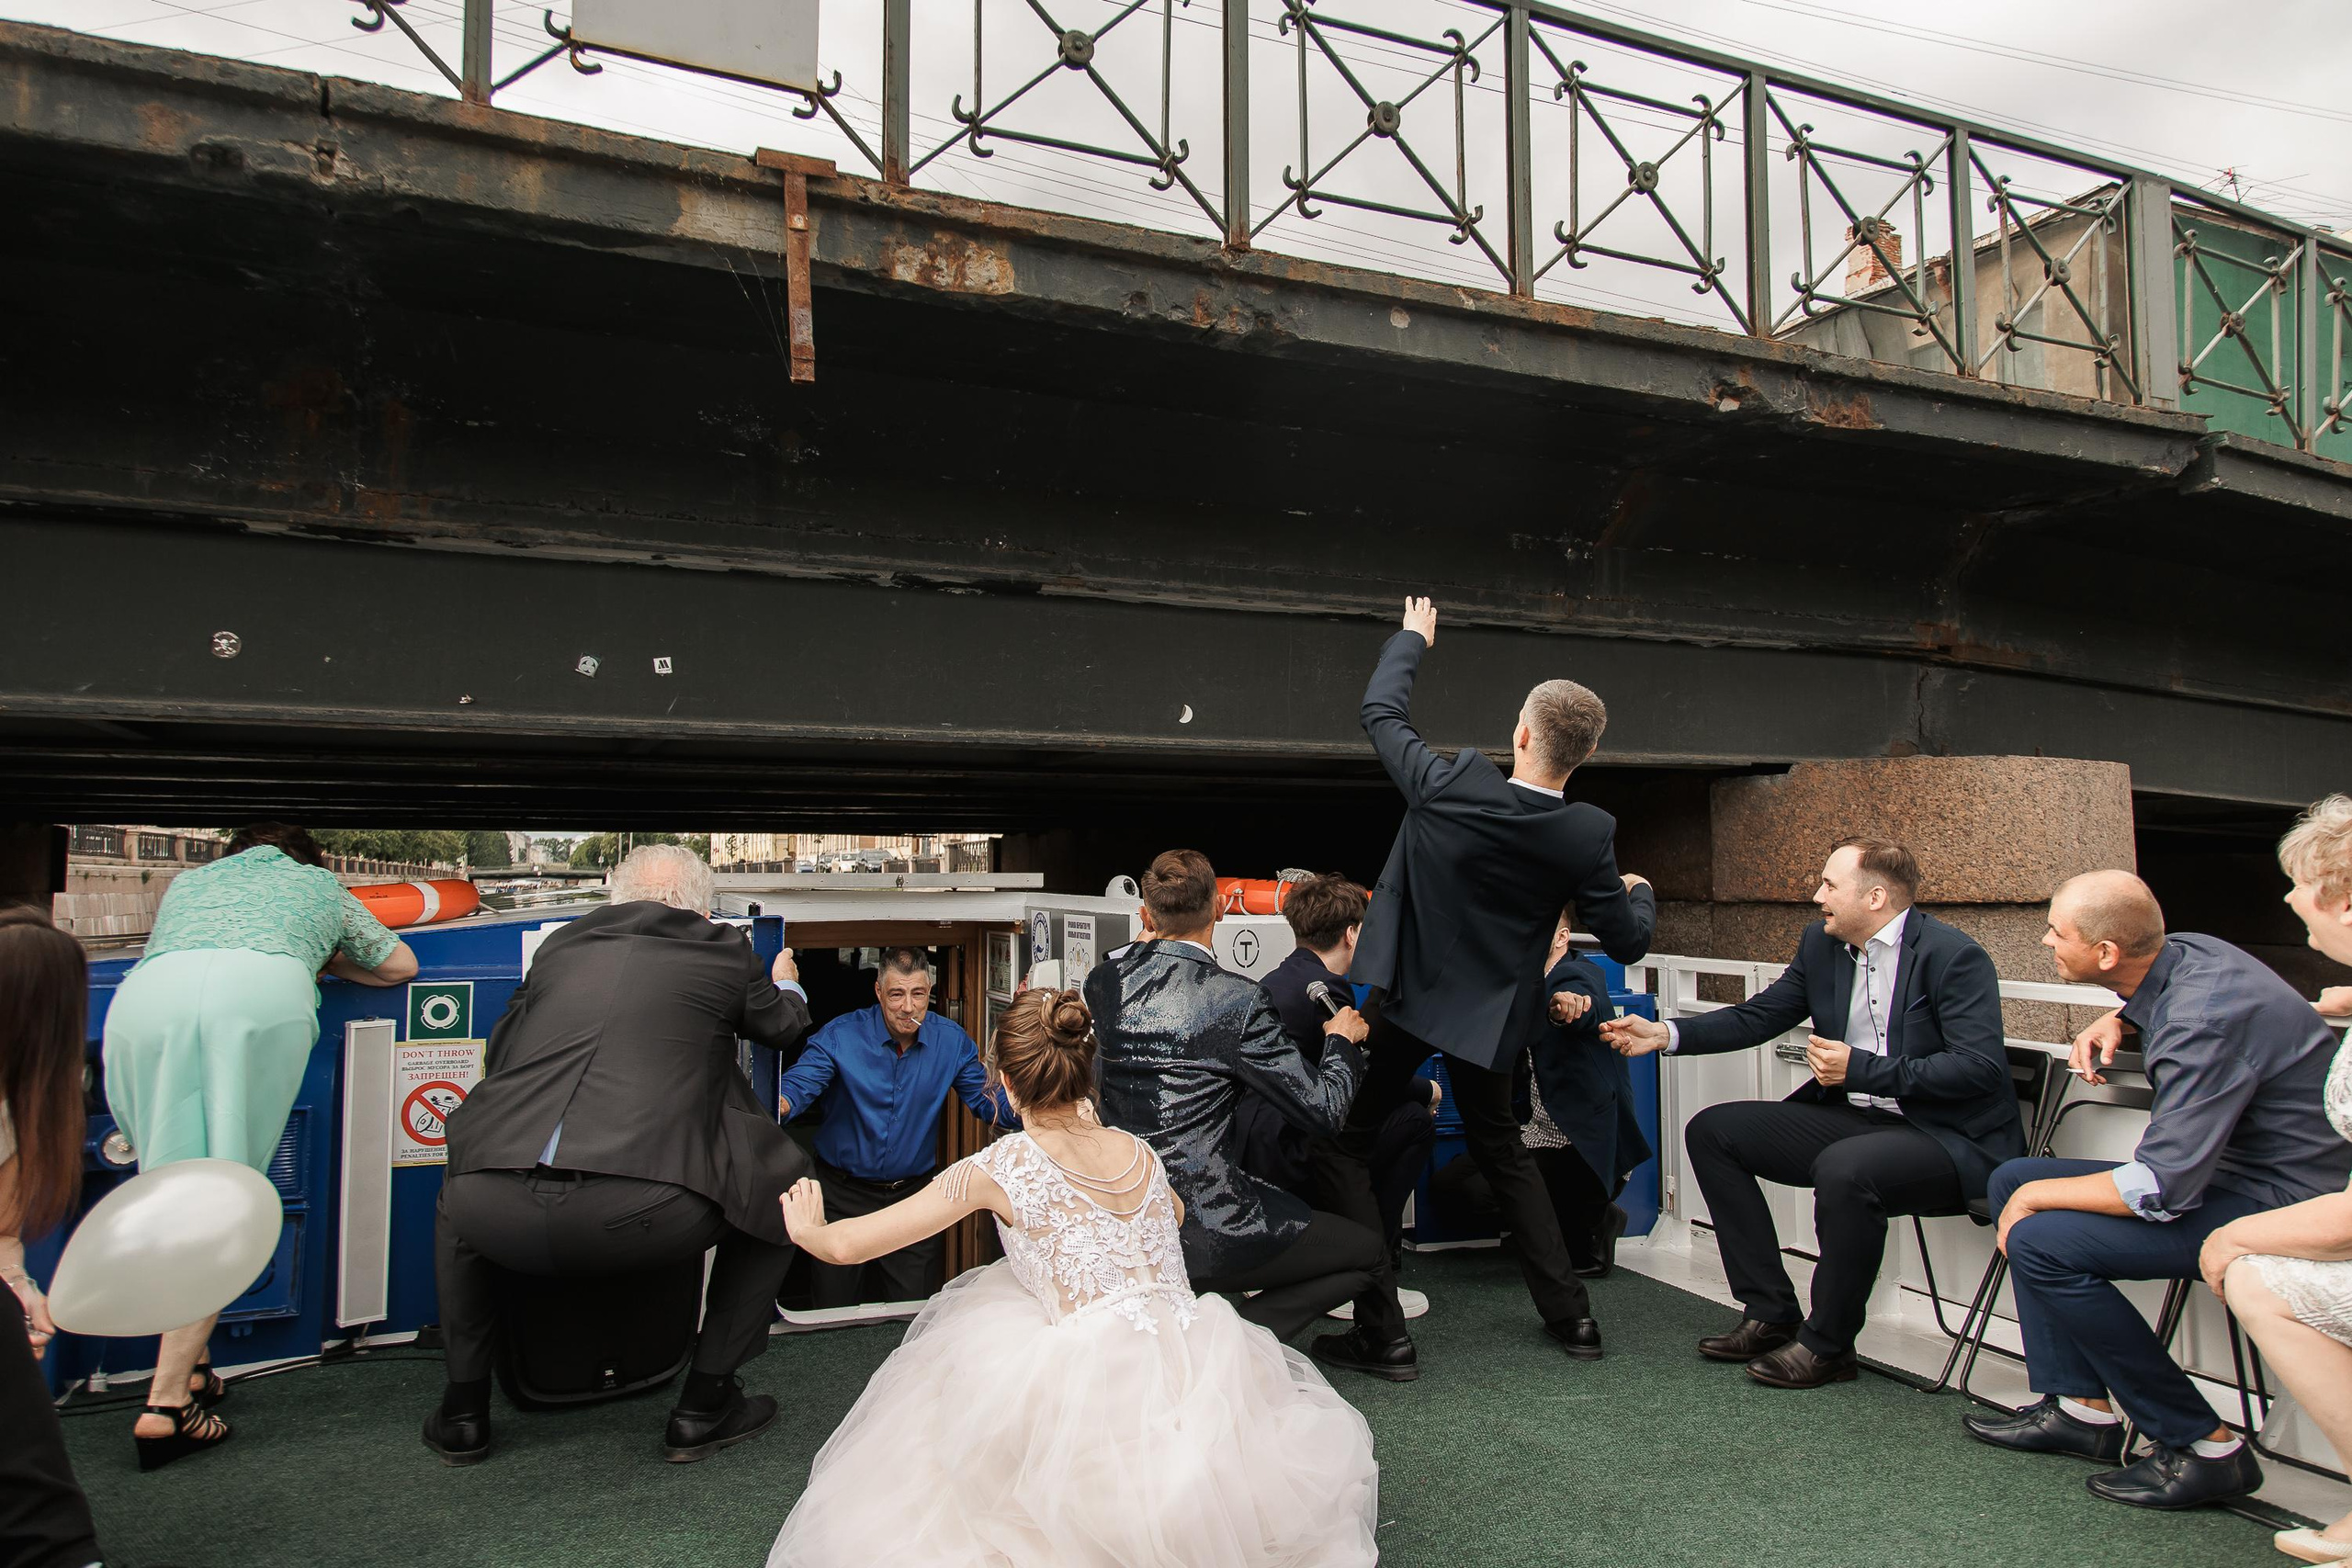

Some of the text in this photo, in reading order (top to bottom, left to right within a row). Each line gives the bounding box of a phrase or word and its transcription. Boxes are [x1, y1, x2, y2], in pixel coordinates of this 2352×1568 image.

[402, 1049, 475, 1059] DON'T THROW
[407, 1071, 469, 1080] ЗАПРЕЩЕН!
